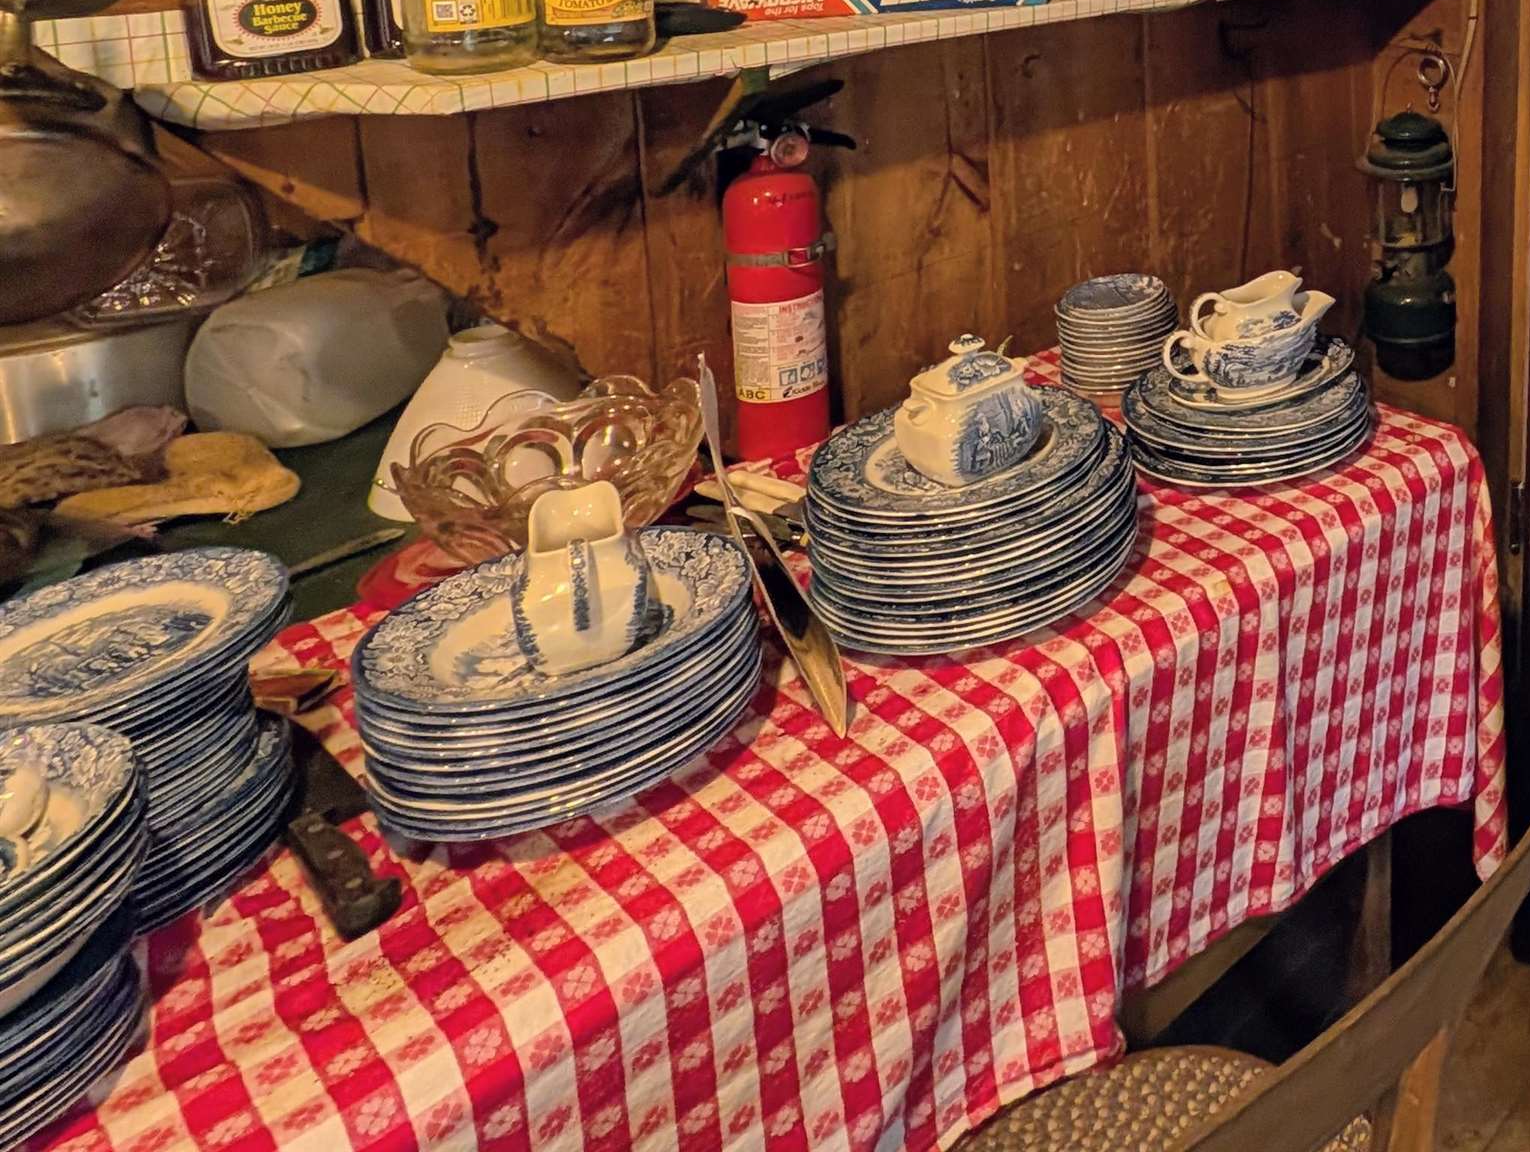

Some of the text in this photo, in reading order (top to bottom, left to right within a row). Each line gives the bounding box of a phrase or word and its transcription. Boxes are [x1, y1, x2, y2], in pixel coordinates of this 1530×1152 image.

[253, 2, 303, 16] Honey
[763, 2, 825, 17] Tops for the
[252, 13, 308, 27] Barbecue
[264, 22, 299, 35] Sauce
[740, 389, 766, 400] ABC
